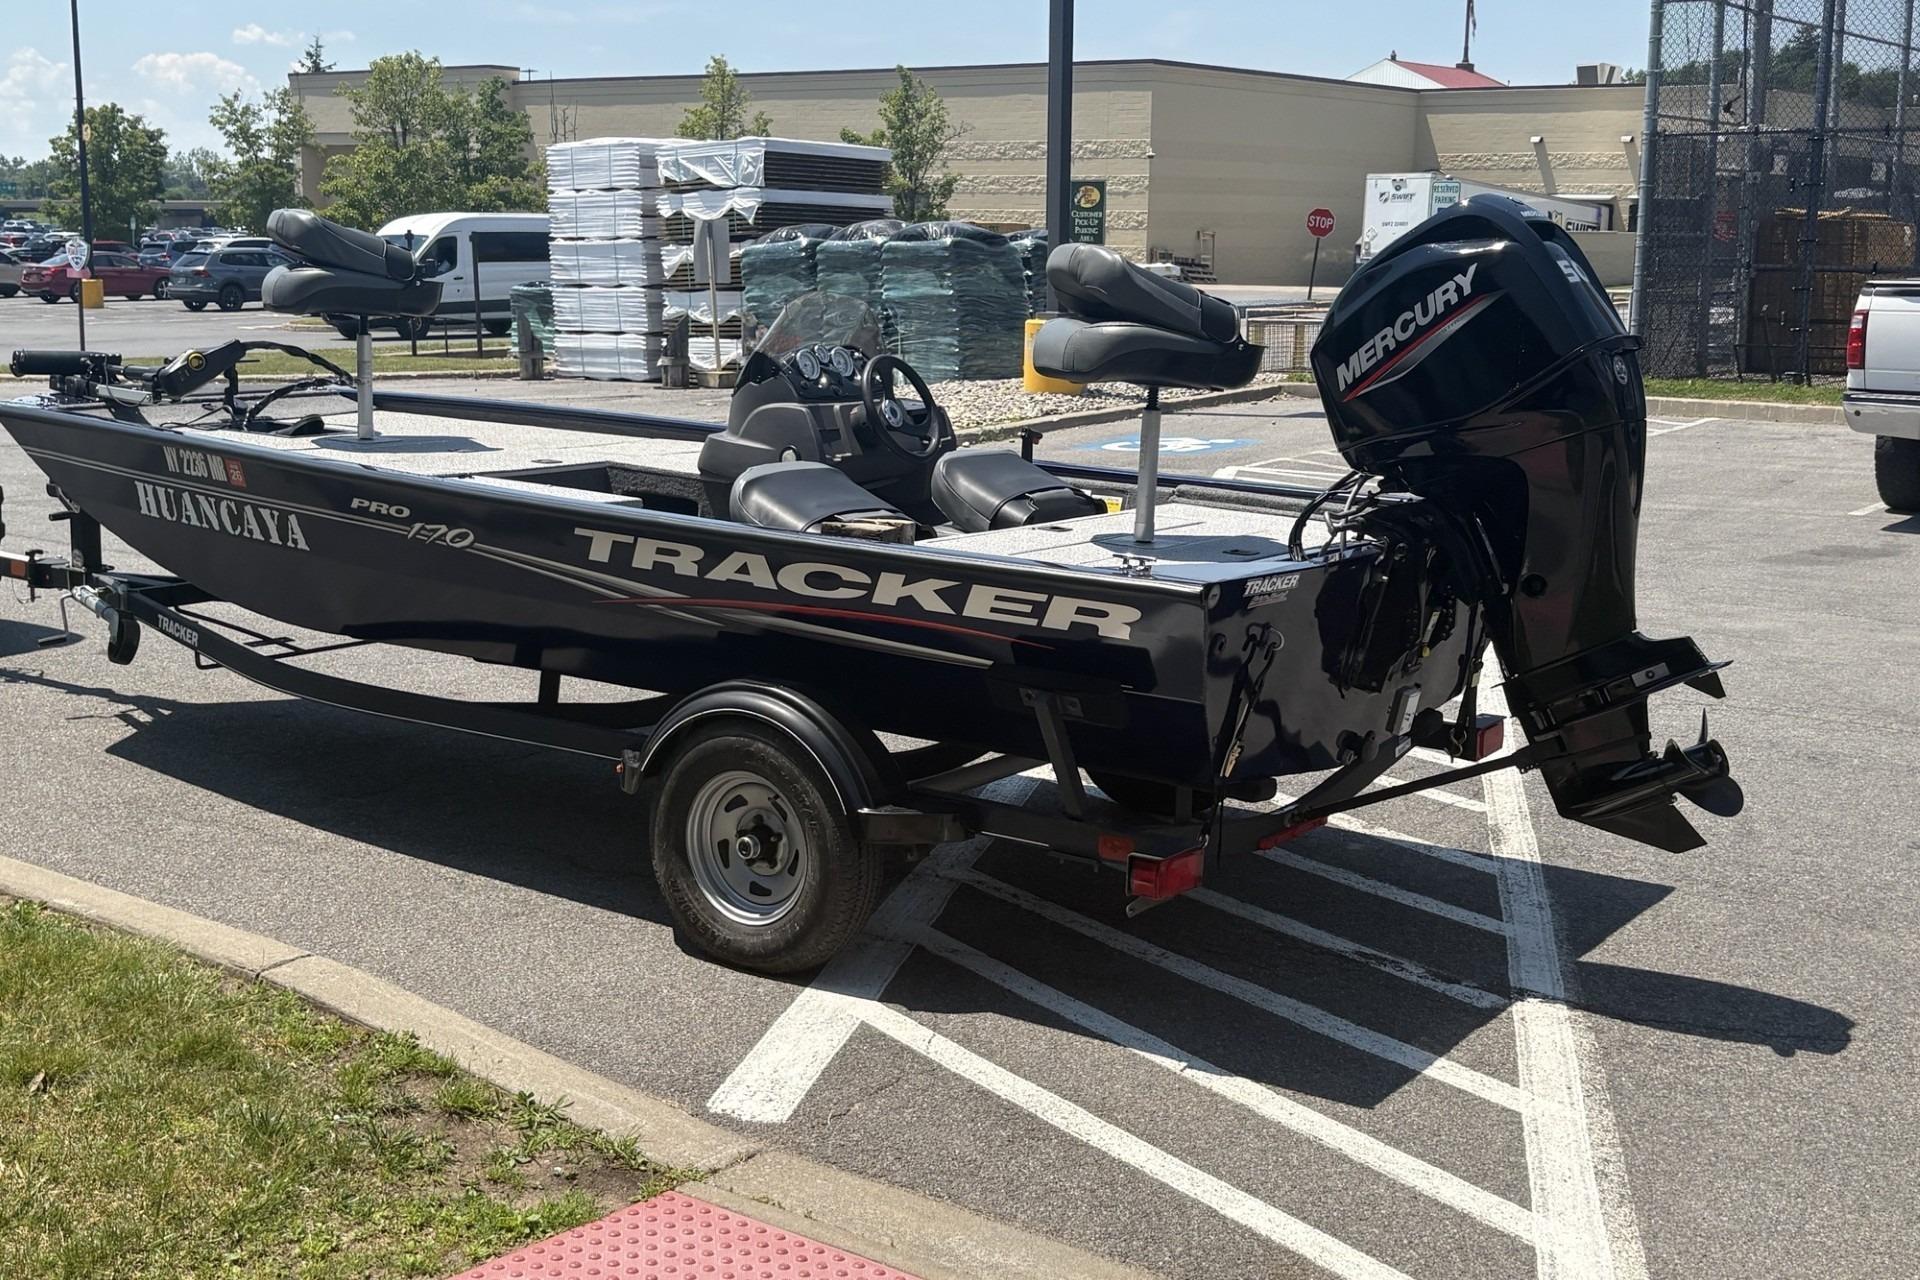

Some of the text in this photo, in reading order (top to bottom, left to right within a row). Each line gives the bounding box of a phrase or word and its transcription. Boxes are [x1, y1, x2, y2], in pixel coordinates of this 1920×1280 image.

[1391, 192, 1415, 200] SWIFT
[1433, 185, 1459, 193] RESERVED
[1434, 196, 1456, 204] PARKING
[1071, 210, 1103, 218] CUSTOMER
[1308, 215, 1334, 229] STOP
[1074, 226, 1099, 234] PARKING
[1336, 262, 1478, 393] MERCURY
[162, 446, 180, 473] NY
[179, 448, 209, 478] 2236
[230, 469, 243, 481] 26
[134, 480, 311, 551] HUANCAYA
[350, 497, 411, 518] PRO
[407, 522, 475, 548] 170
[572, 527, 1143, 640] TRACKER
[1243, 574, 1300, 595] TRACKER
[157, 613, 199, 647] TRACKER
